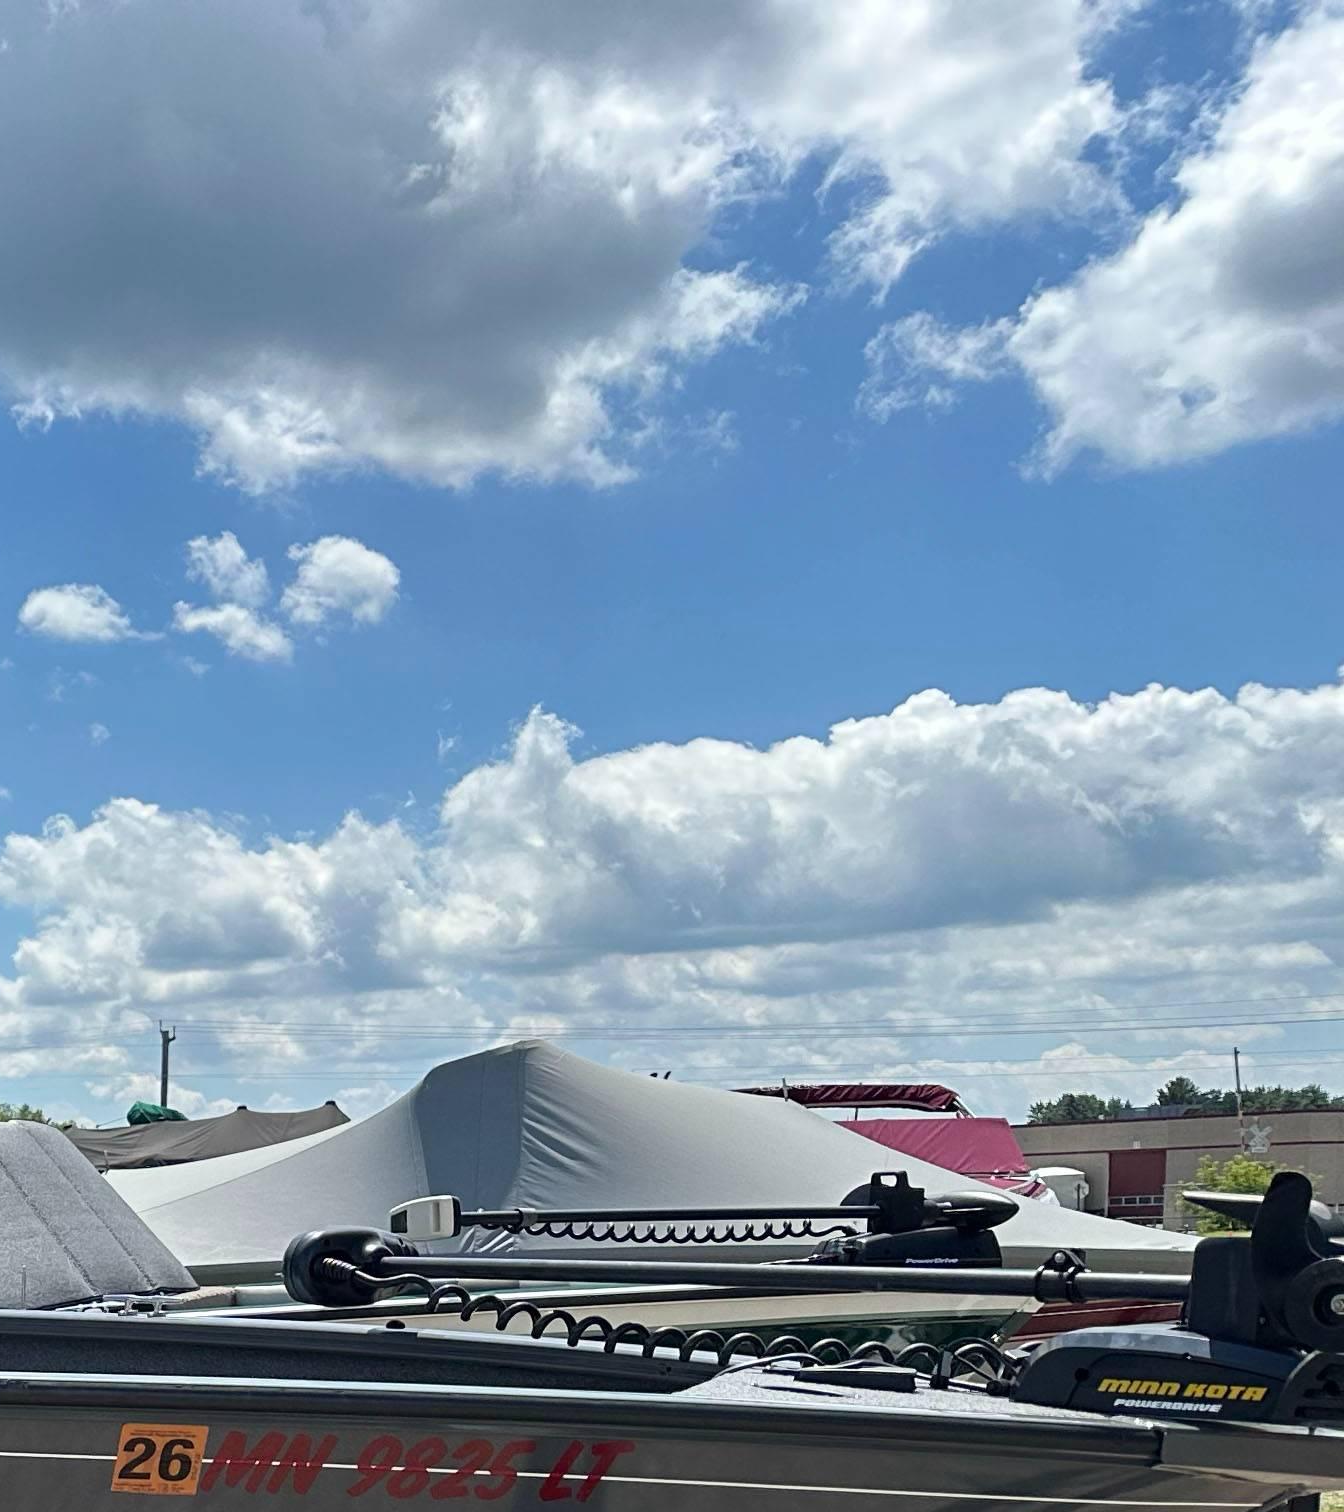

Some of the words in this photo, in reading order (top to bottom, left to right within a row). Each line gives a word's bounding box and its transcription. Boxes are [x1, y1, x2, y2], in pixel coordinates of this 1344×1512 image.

[1097, 1378, 1181, 1396] MINN
[1183, 1382, 1269, 1401] KOTA
[118, 1437, 194, 1482] 26
[199, 1430, 340, 1496] MN
[346, 1438, 538, 1501] 9825
[538, 1440, 635, 1502] LT
